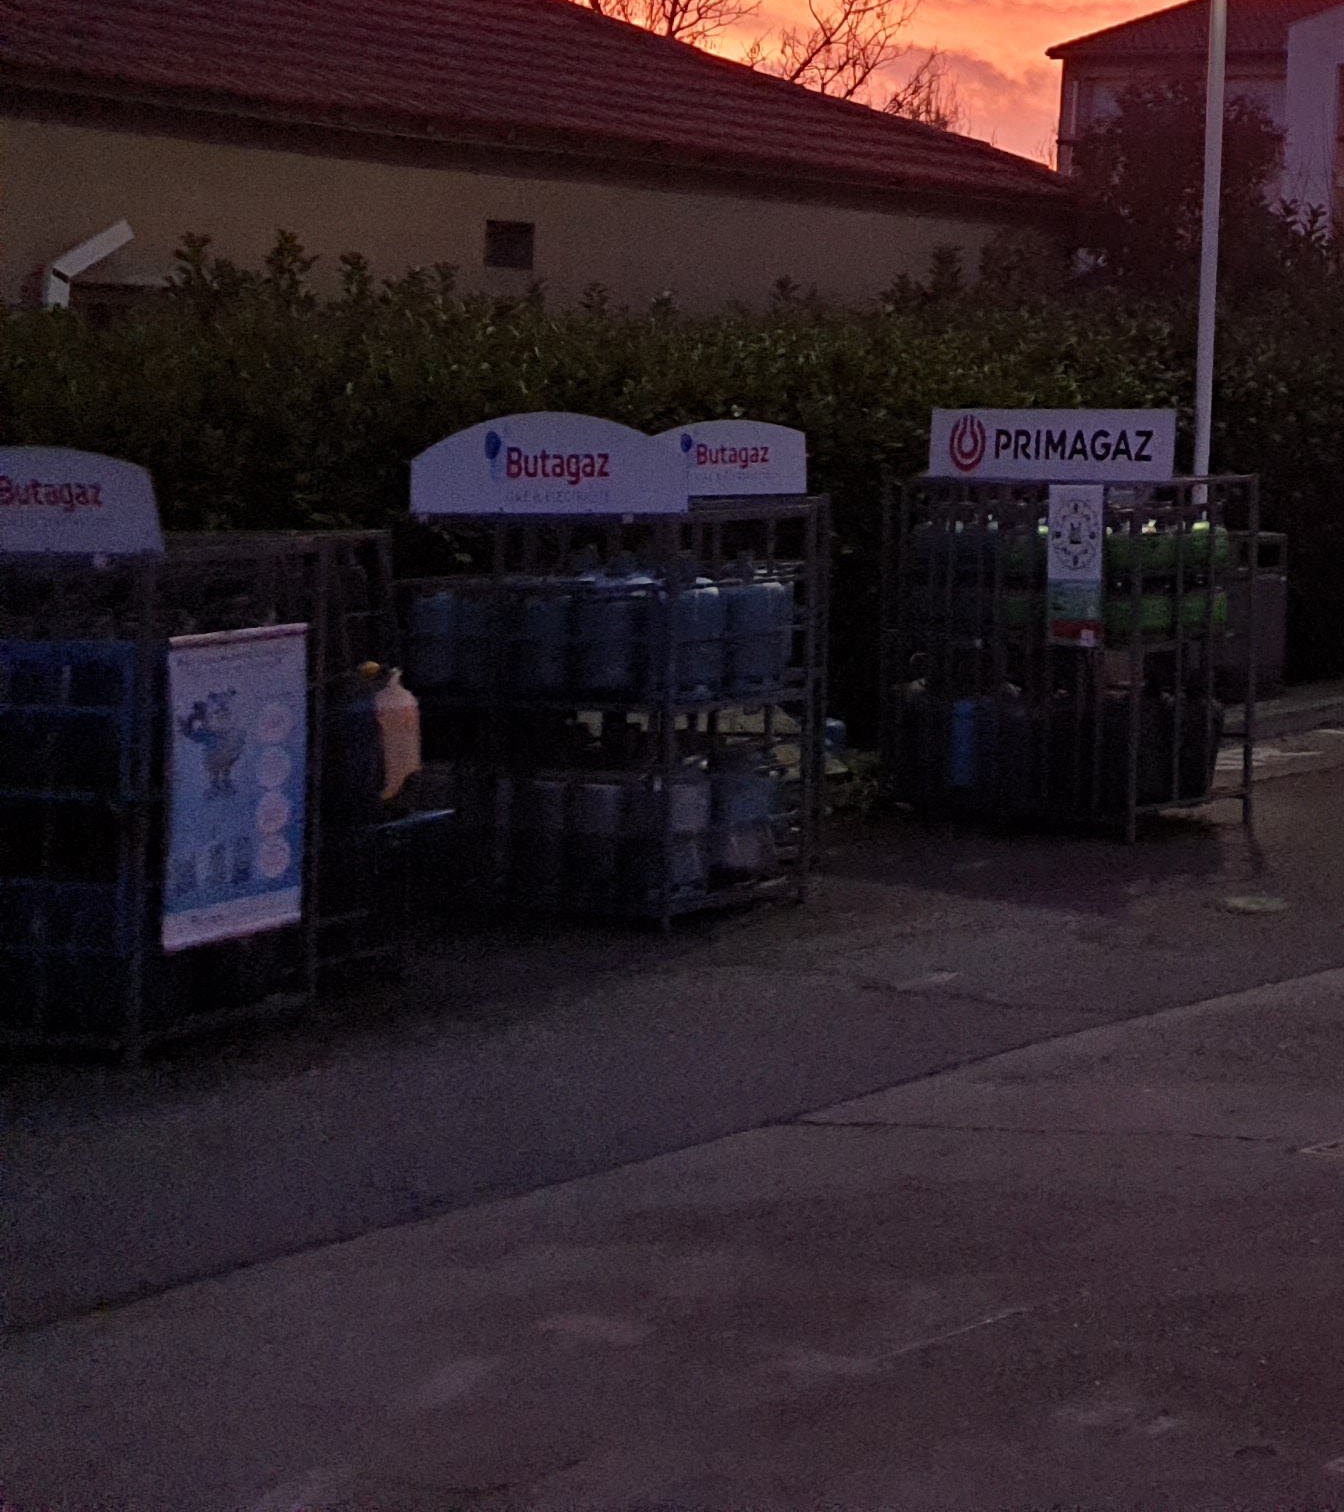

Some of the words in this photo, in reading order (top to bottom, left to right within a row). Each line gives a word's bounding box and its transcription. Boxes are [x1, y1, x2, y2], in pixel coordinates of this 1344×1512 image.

[695, 443, 770, 470] Butagaz
[994, 427, 1154, 464] PRIMAGAZ
[505, 446, 610, 486] Butagaz
[0, 474, 104, 513] Butagaz
